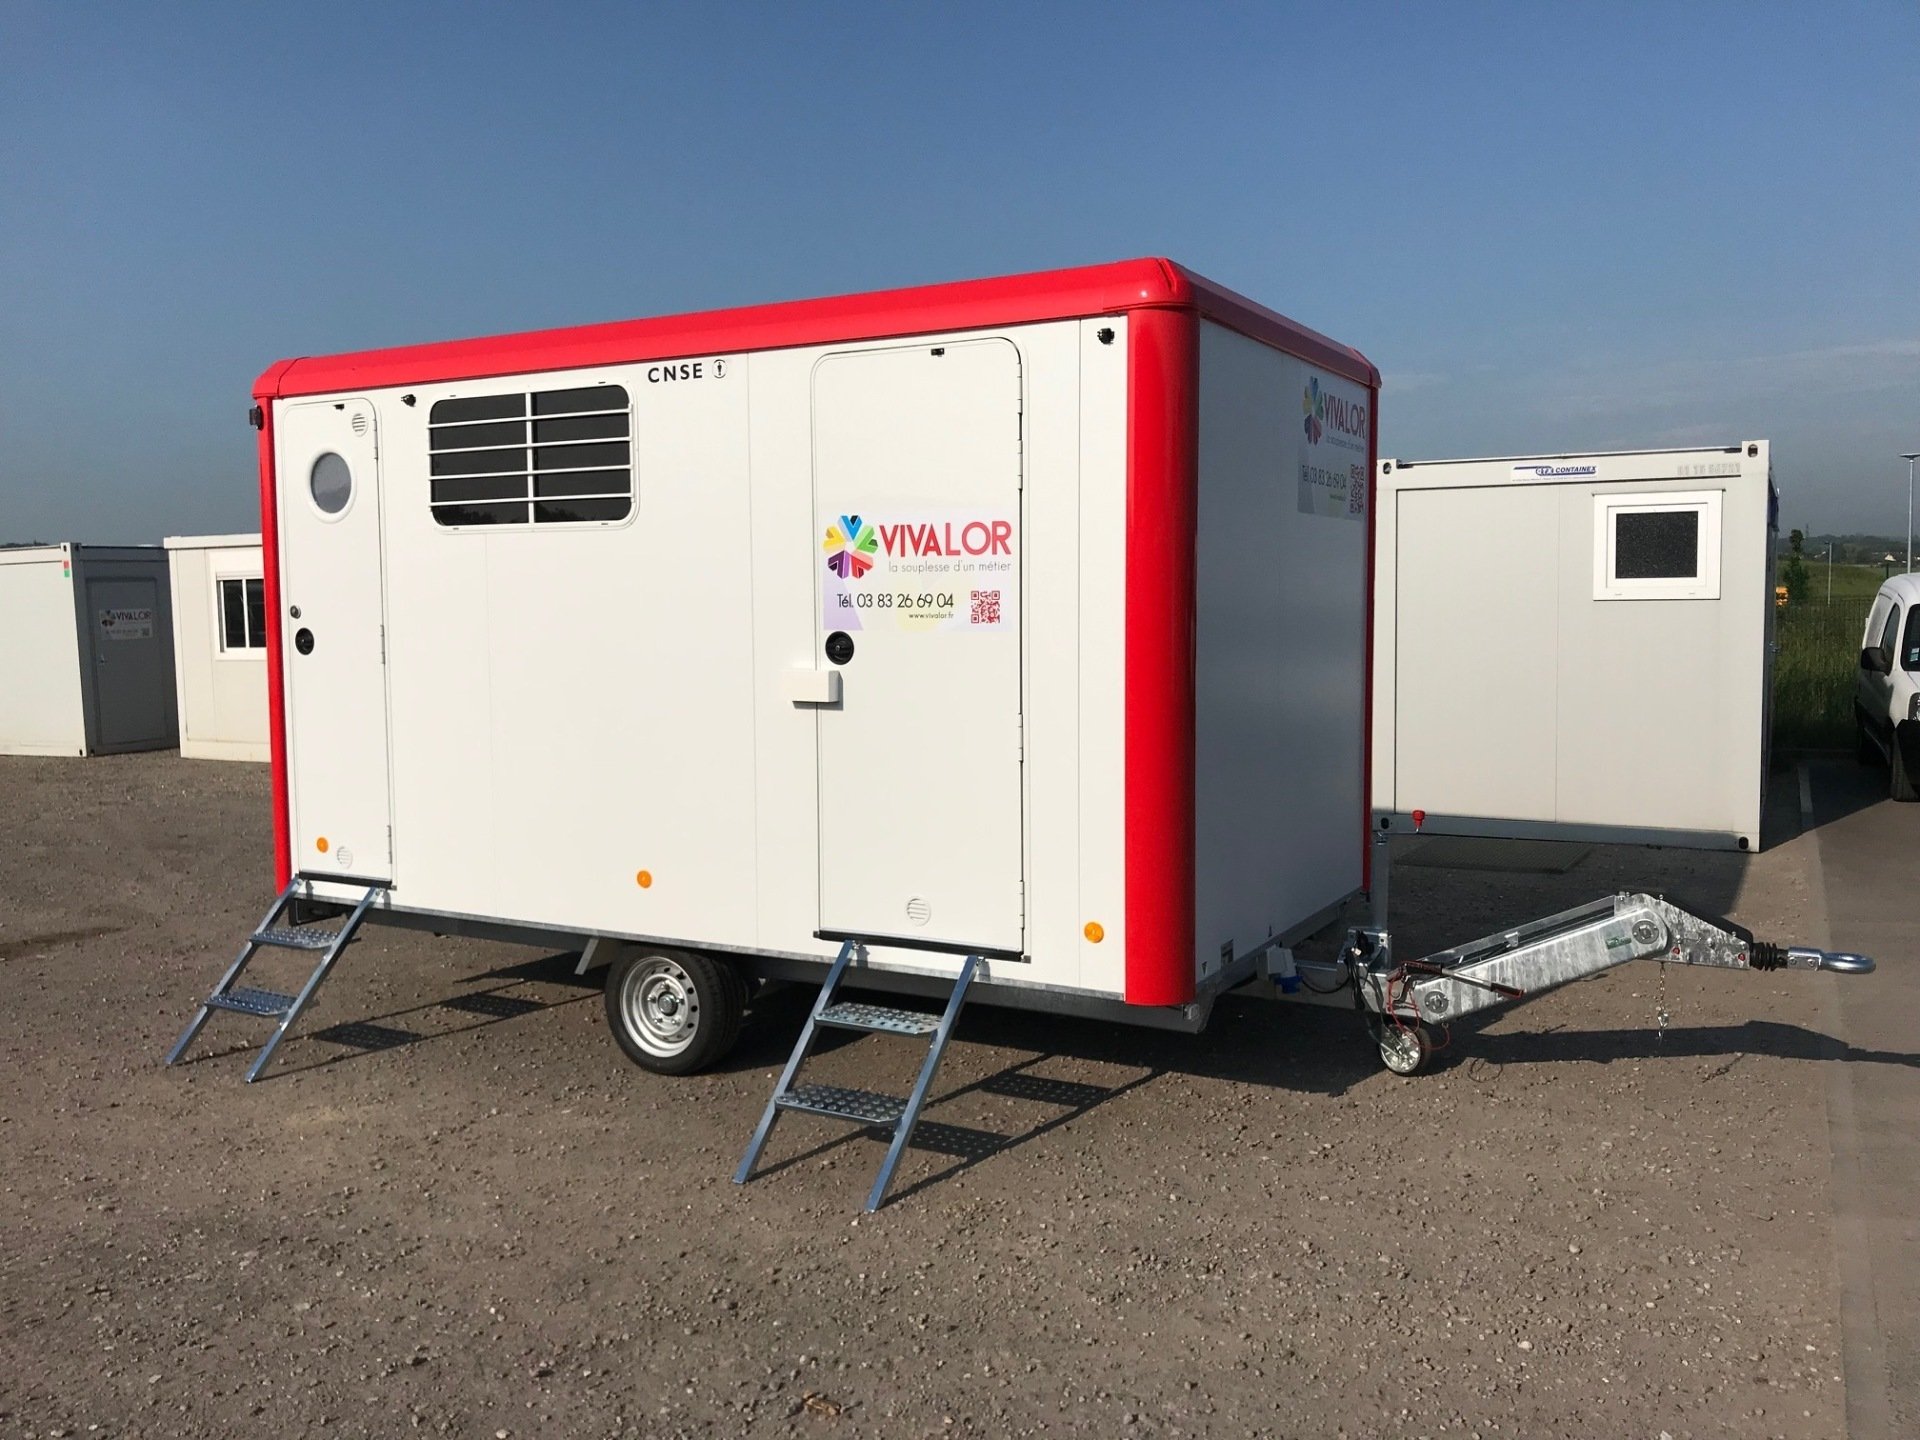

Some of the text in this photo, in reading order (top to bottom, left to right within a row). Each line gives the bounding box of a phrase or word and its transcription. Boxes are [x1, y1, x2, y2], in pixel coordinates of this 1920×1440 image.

[647, 362, 703, 383] CNSE
[1323, 391, 1366, 439] VIVALOR
[1555, 465, 1597, 474] CONTAINEX
[879, 521, 1012, 558] VIVALOR
[888, 560, 1012, 575] la souplesse d'un métier
[836, 593, 954, 608] Tél. 03 83 26 69 04
[116, 610, 152, 621] VIVALOR
[908, 611, 954, 620] www.vivalor.fr
